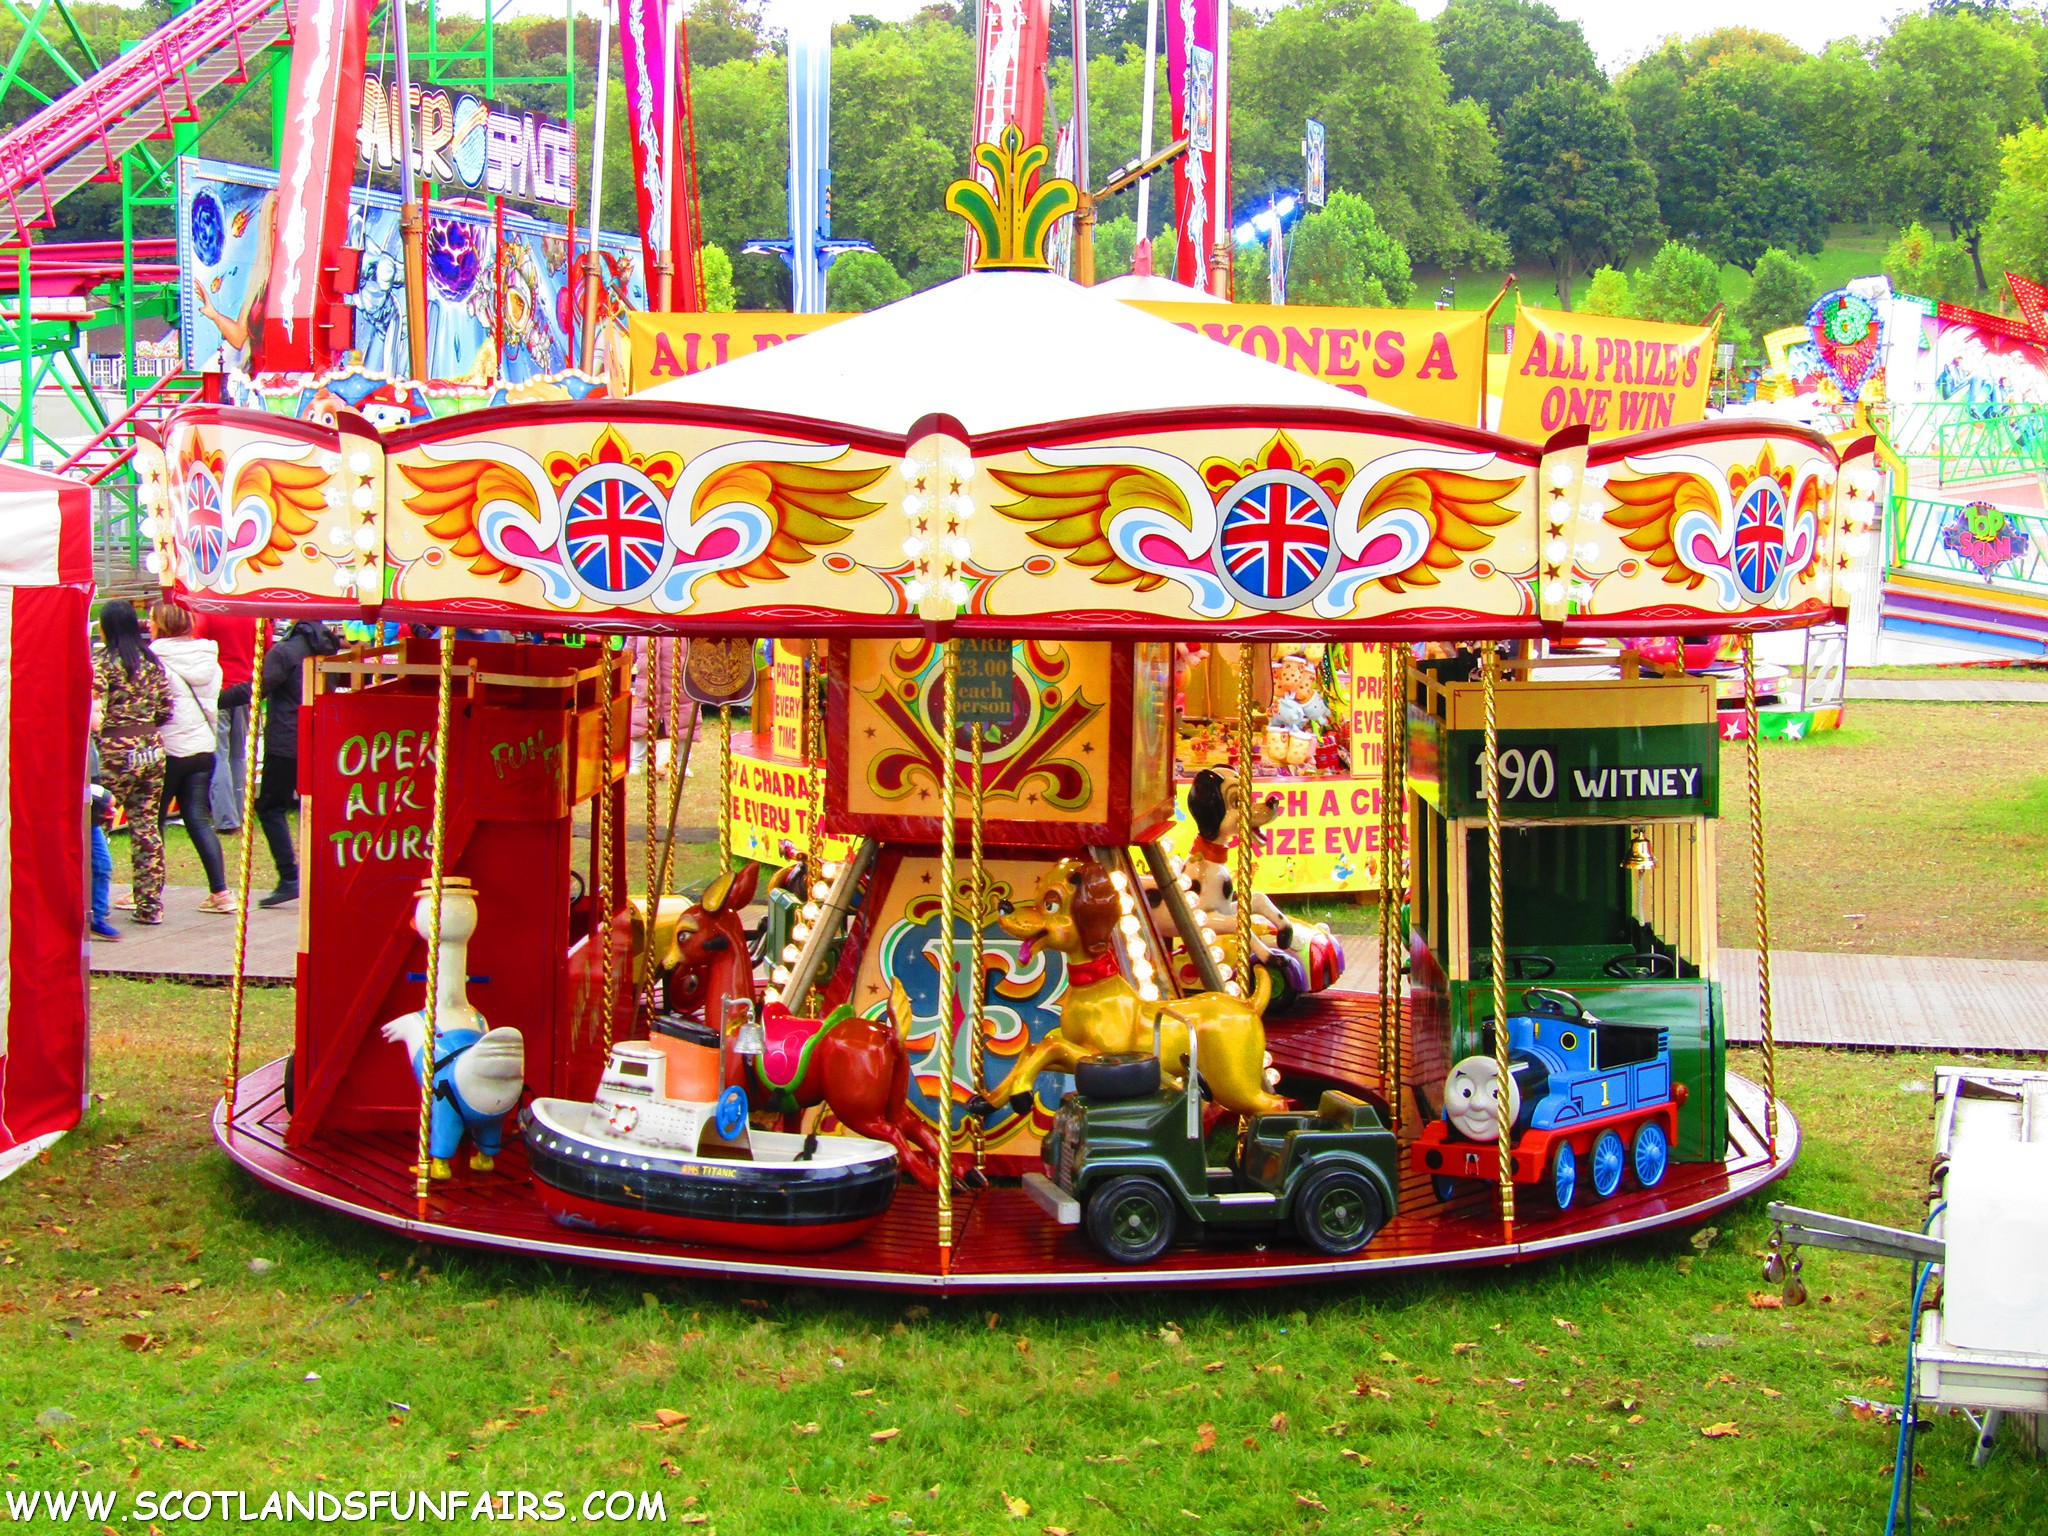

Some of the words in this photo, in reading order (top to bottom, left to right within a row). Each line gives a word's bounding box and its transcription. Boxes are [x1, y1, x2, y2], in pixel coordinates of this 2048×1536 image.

[1417, 332, 1458, 380] A
[1520, 330, 1589, 381] ALL
[1594, 337, 1701, 388] PRIZE'S
[1541, 386, 1612, 432] ONE
[1619, 391, 1676, 431] WIN
[1964, 506, 2005, 540] TOP
[1960, 532, 2011, 567] SCAN
[776, 662, 800, 687] PRIZE
[958, 680, 1003, 700] each
[775, 695, 800, 719] EVERY
[777, 725, 797, 750] TIME
[740, 763, 749, 789] A
[1573, 767, 1698, 798] WITNEY
[346, 776, 428, 821] AIR
[1319, 789, 1340, 816] A
[744, 798, 790, 834] EVERY
[1601, 1081, 1611, 1107] 1
[702, 1165, 737, 1178] TITANIC
